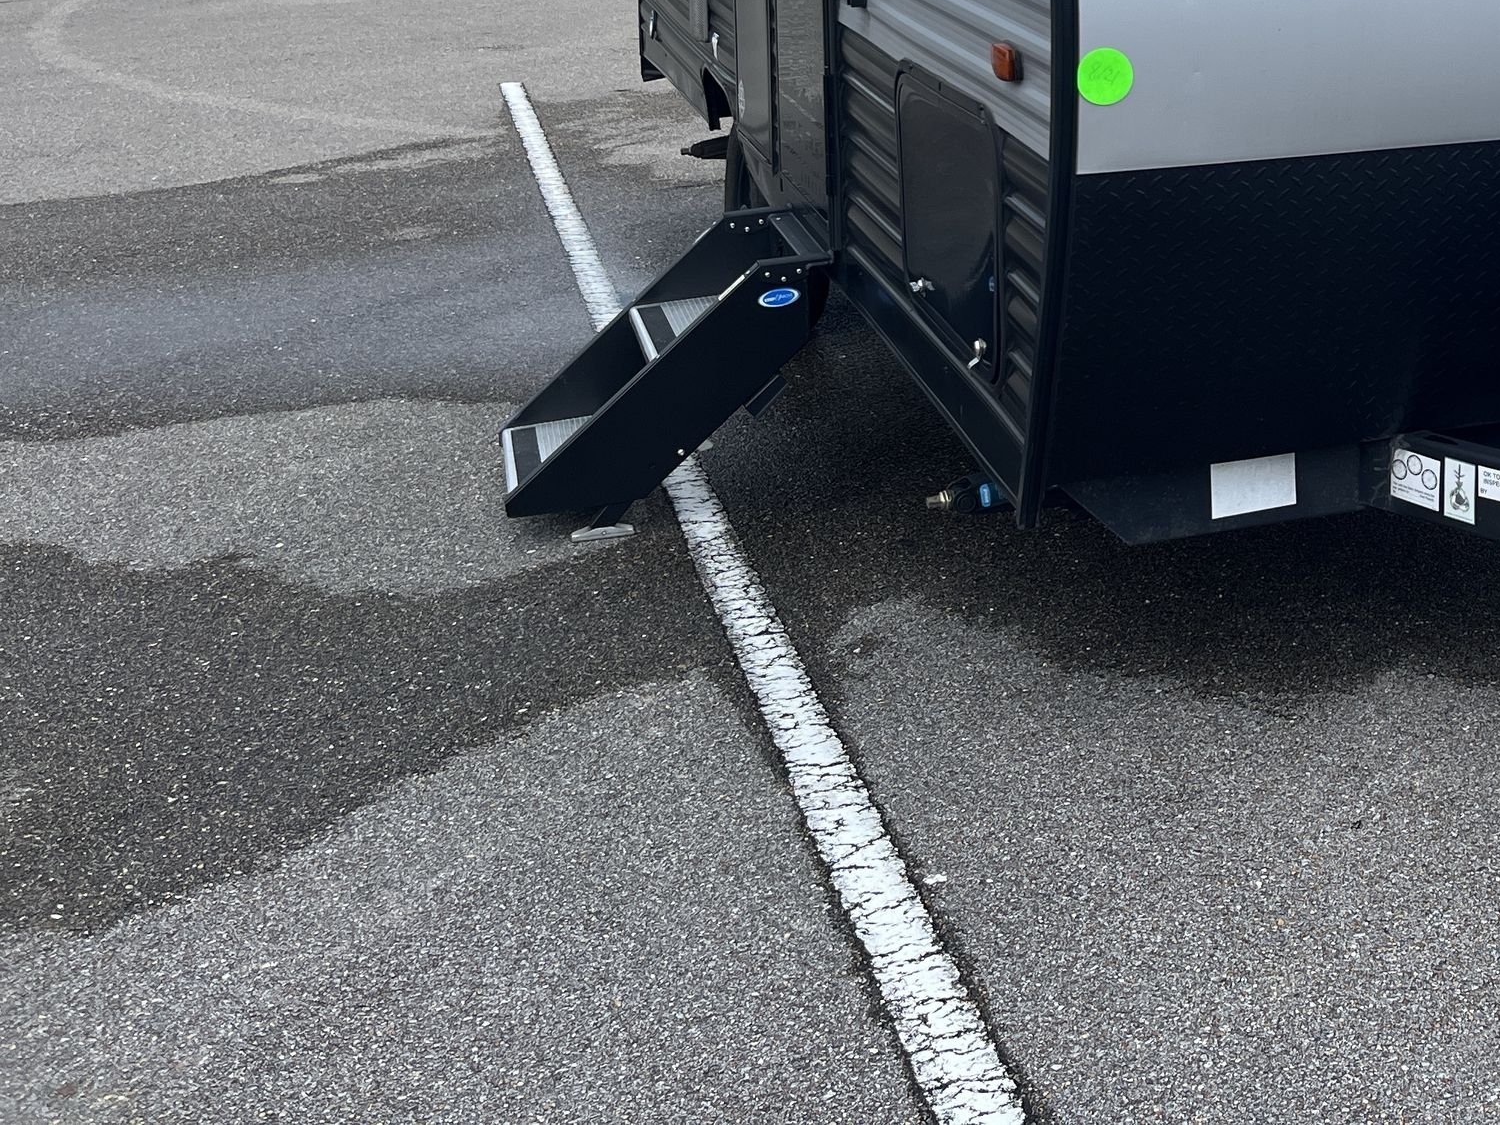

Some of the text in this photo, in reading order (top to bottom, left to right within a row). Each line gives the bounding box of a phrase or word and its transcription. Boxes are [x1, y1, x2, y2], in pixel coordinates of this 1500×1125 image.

[1483, 470, 1492, 478] OK
[1493, 472, 1500, 481] TO
[1480, 487, 1488, 495] BY
